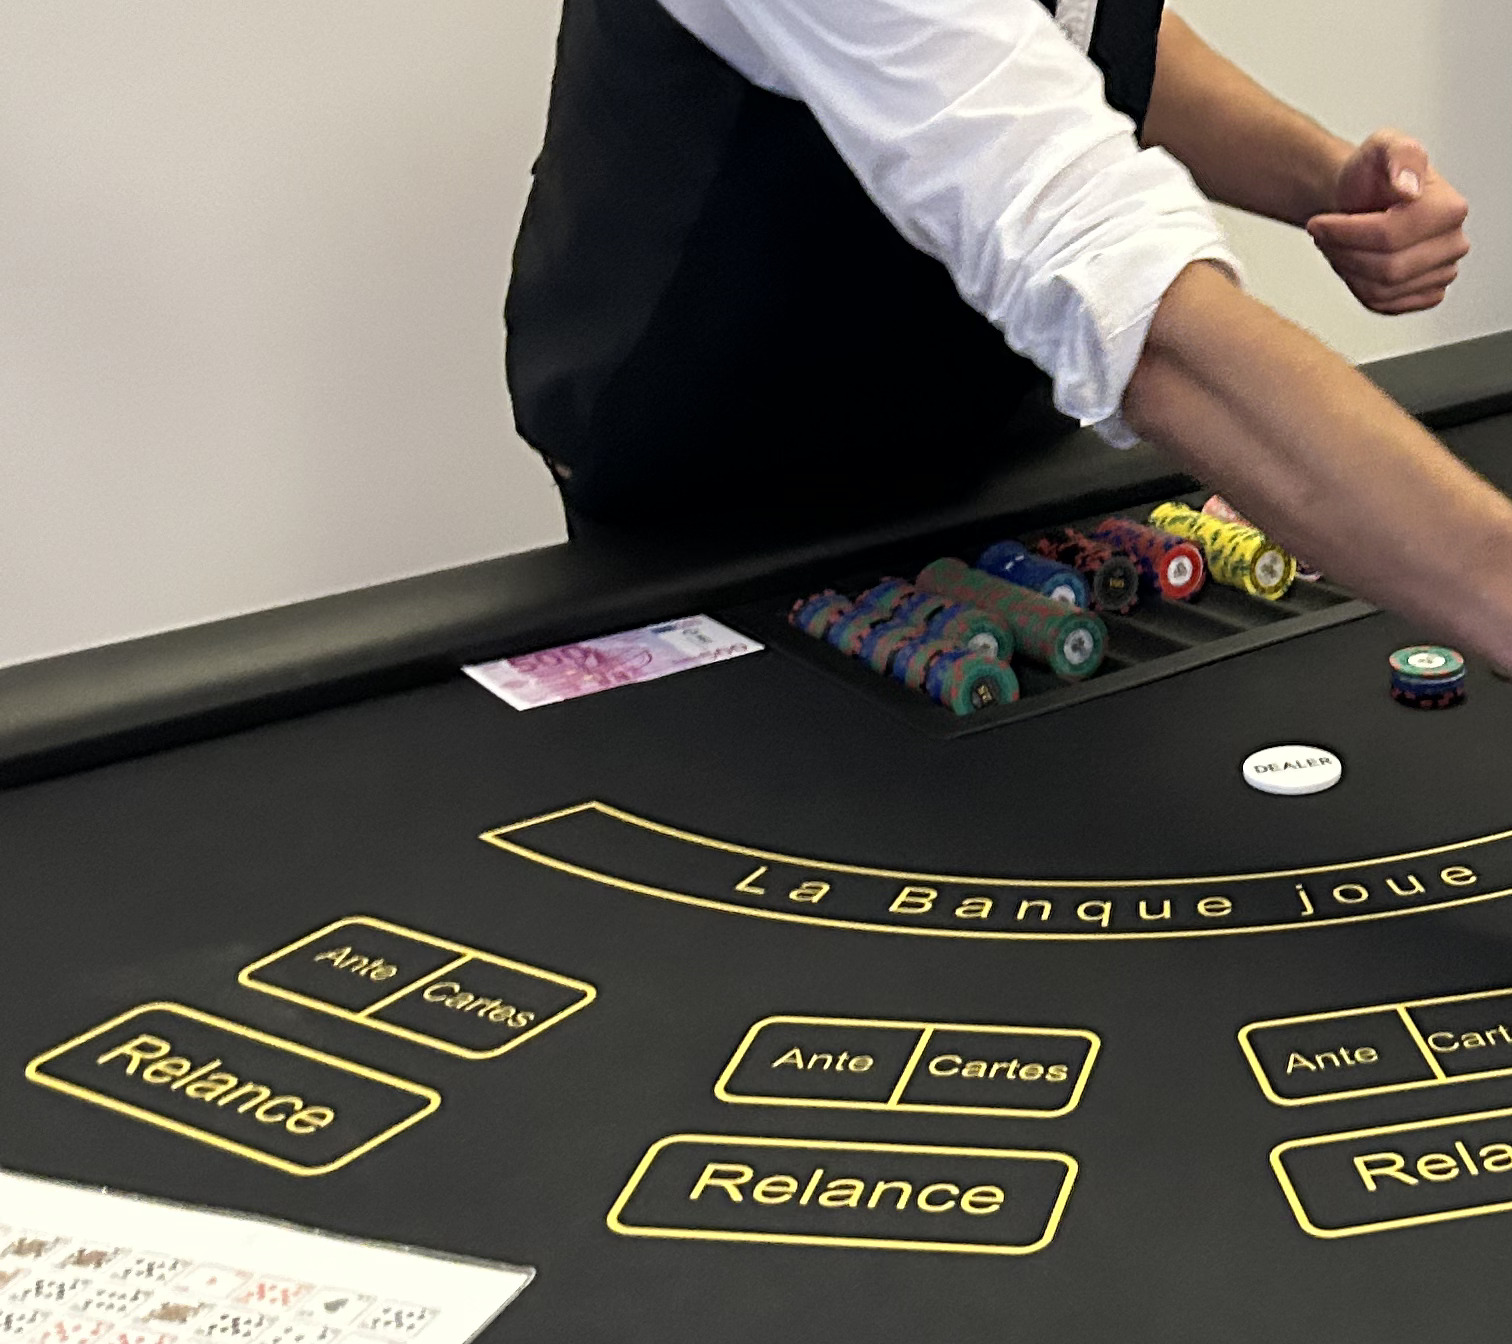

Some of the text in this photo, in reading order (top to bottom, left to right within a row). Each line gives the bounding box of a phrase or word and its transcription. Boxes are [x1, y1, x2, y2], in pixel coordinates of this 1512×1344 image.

[1253, 757, 1332, 774] DEALER
[735, 866, 831, 904] La
[888, 885, 1234, 927] Banque
[1296, 863, 1478, 916] joue
[313, 944, 534, 1030] Ante Cartes
[97, 1033, 335, 1135] Relance
[770, 1047, 1069, 1083] Ante Cartes
[1285, 1042, 1379, 1075] Ante
[688, 1162, 1006, 1215] Relance
